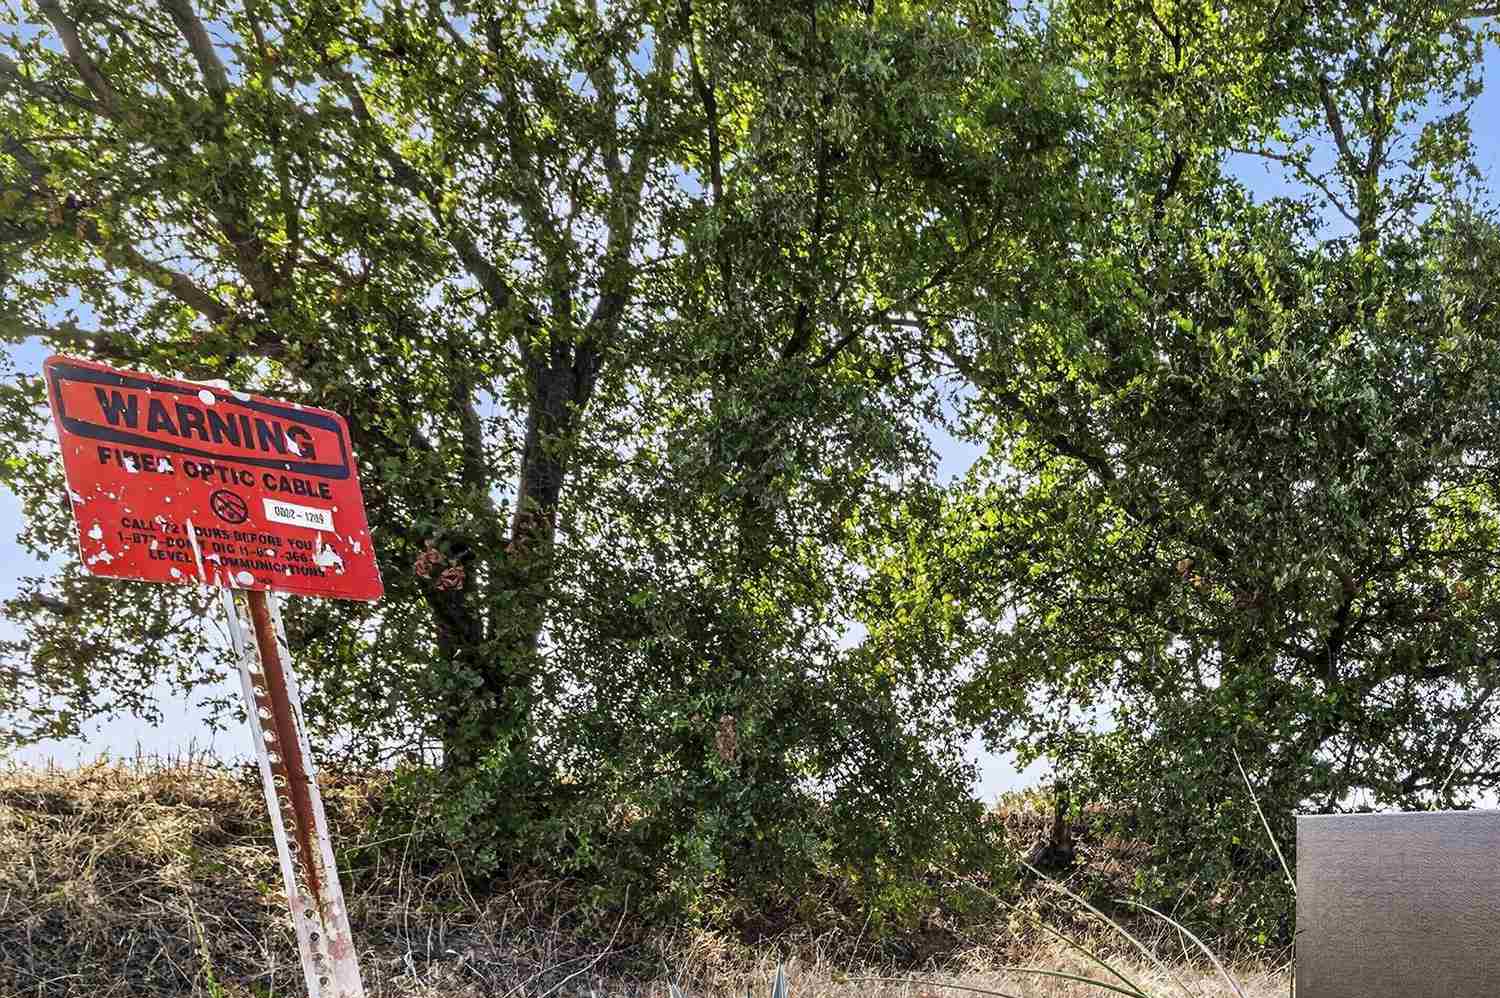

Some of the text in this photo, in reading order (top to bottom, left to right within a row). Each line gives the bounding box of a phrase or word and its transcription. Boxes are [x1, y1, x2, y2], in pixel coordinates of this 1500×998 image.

[94, 388, 316, 461] WARNING
[184, 460, 255, 486] OPTIC
[262, 473, 333, 500] CABLE
[121, 518, 154, 532] CALL
[288, 538, 312, 550] YOU
[213, 543, 235, 554] DIG
[149, 549, 193, 563] LEVEL
